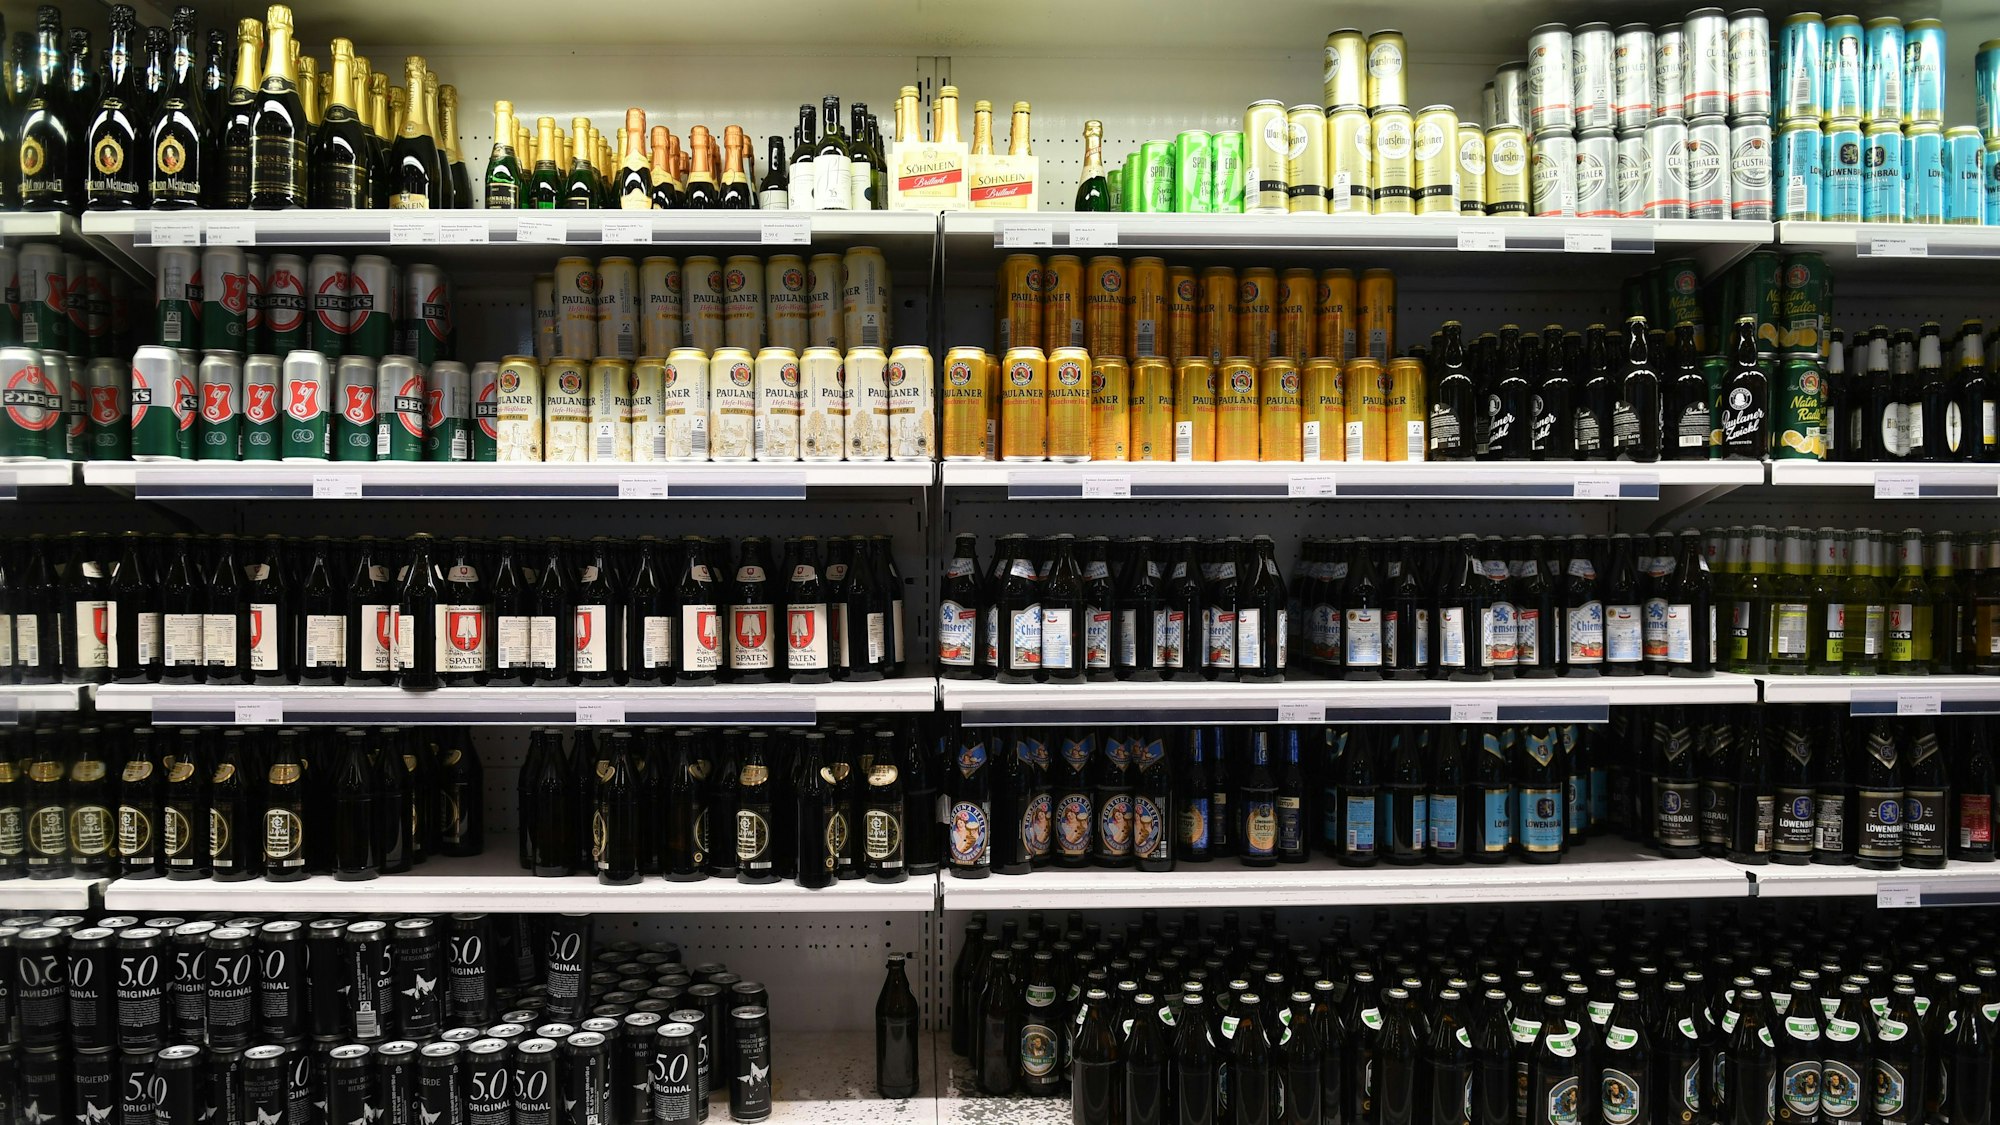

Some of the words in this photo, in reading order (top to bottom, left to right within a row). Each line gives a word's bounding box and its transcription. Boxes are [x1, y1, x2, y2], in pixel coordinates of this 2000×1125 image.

[1370, 58, 1400, 68] Warsteiner
[1378, 135, 1410, 147] Warsteiner
[906, 160, 954, 174] SÖHNLEIN
[1688, 157, 1720, 169] STHALER
[1733, 157, 1771, 170] CLAUSTHA
[1825, 166, 1863, 178] LÖWENBR
[1864, 168, 1898, 180] WENBRÄU
[913, 175, 947, 188] Brillant
[978, 172, 1025, 186] SÖHNLEIN
[106, 178, 139, 192] Metternich
[168, 178, 200, 192] Metternich
[986, 187, 1017, 199] Brillant
[269, 296, 305, 307] ECK'S
[317, 297, 348, 308] BEC
[562, 294, 595, 305] PAULA
[650, 294, 681, 304] PAULA
[770, 293, 808, 303] PAULAN
[1011, 293, 1043, 302] PAULA
[133, 390, 150, 401] K'S
[716, 388, 755, 398] PAULAN
[765, 388, 799, 398] PAULAN
[822, 388, 843, 398] PAUL
[868, 388, 888, 398] PAUL
[1048, 389, 1090, 398] PAULANER
[397, 400, 422, 410] BEC
[498, 396, 532, 406] ULANER
[547, 397, 588, 406] PAULANE
[1192, 396, 1215, 405] PAUL
[1218, 396, 1258, 405] PAULANE
[1266, 396, 1300, 405] PAULAN
[1320, 396, 1343, 405] PAUL
[1790, 395, 1817, 409] Natur
[1722, 408, 1765, 430] Paulaner
[1726, 420, 1759, 441] Zwickl
[941, 623, 966, 633] emseer
[1021, 624, 1040, 635] Chiem
[1576, 621, 1602, 631] Chiems
[1779, 818, 1814, 828] LÖWENBRÄ
[1866, 823, 1903, 832] LÖWENBRÄ
[119, 955, 158, 987] 5,0
[211, 954, 251, 987] 5,0
[550, 962, 581, 972] IGINAL
[261, 980, 290, 990] GINAL
[70, 989, 98, 998] GINAL
[117, 987, 162, 998] ORIGINAL
[208, 986, 252, 998] ORIGINAL
[654, 1053, 688, 1083] 5,0
[470, 1068, 507, 1101] 5,0
[123, 1103, 154, 1112] ORIGI
[469, 1100, 511, 1112] ORIGINAL
